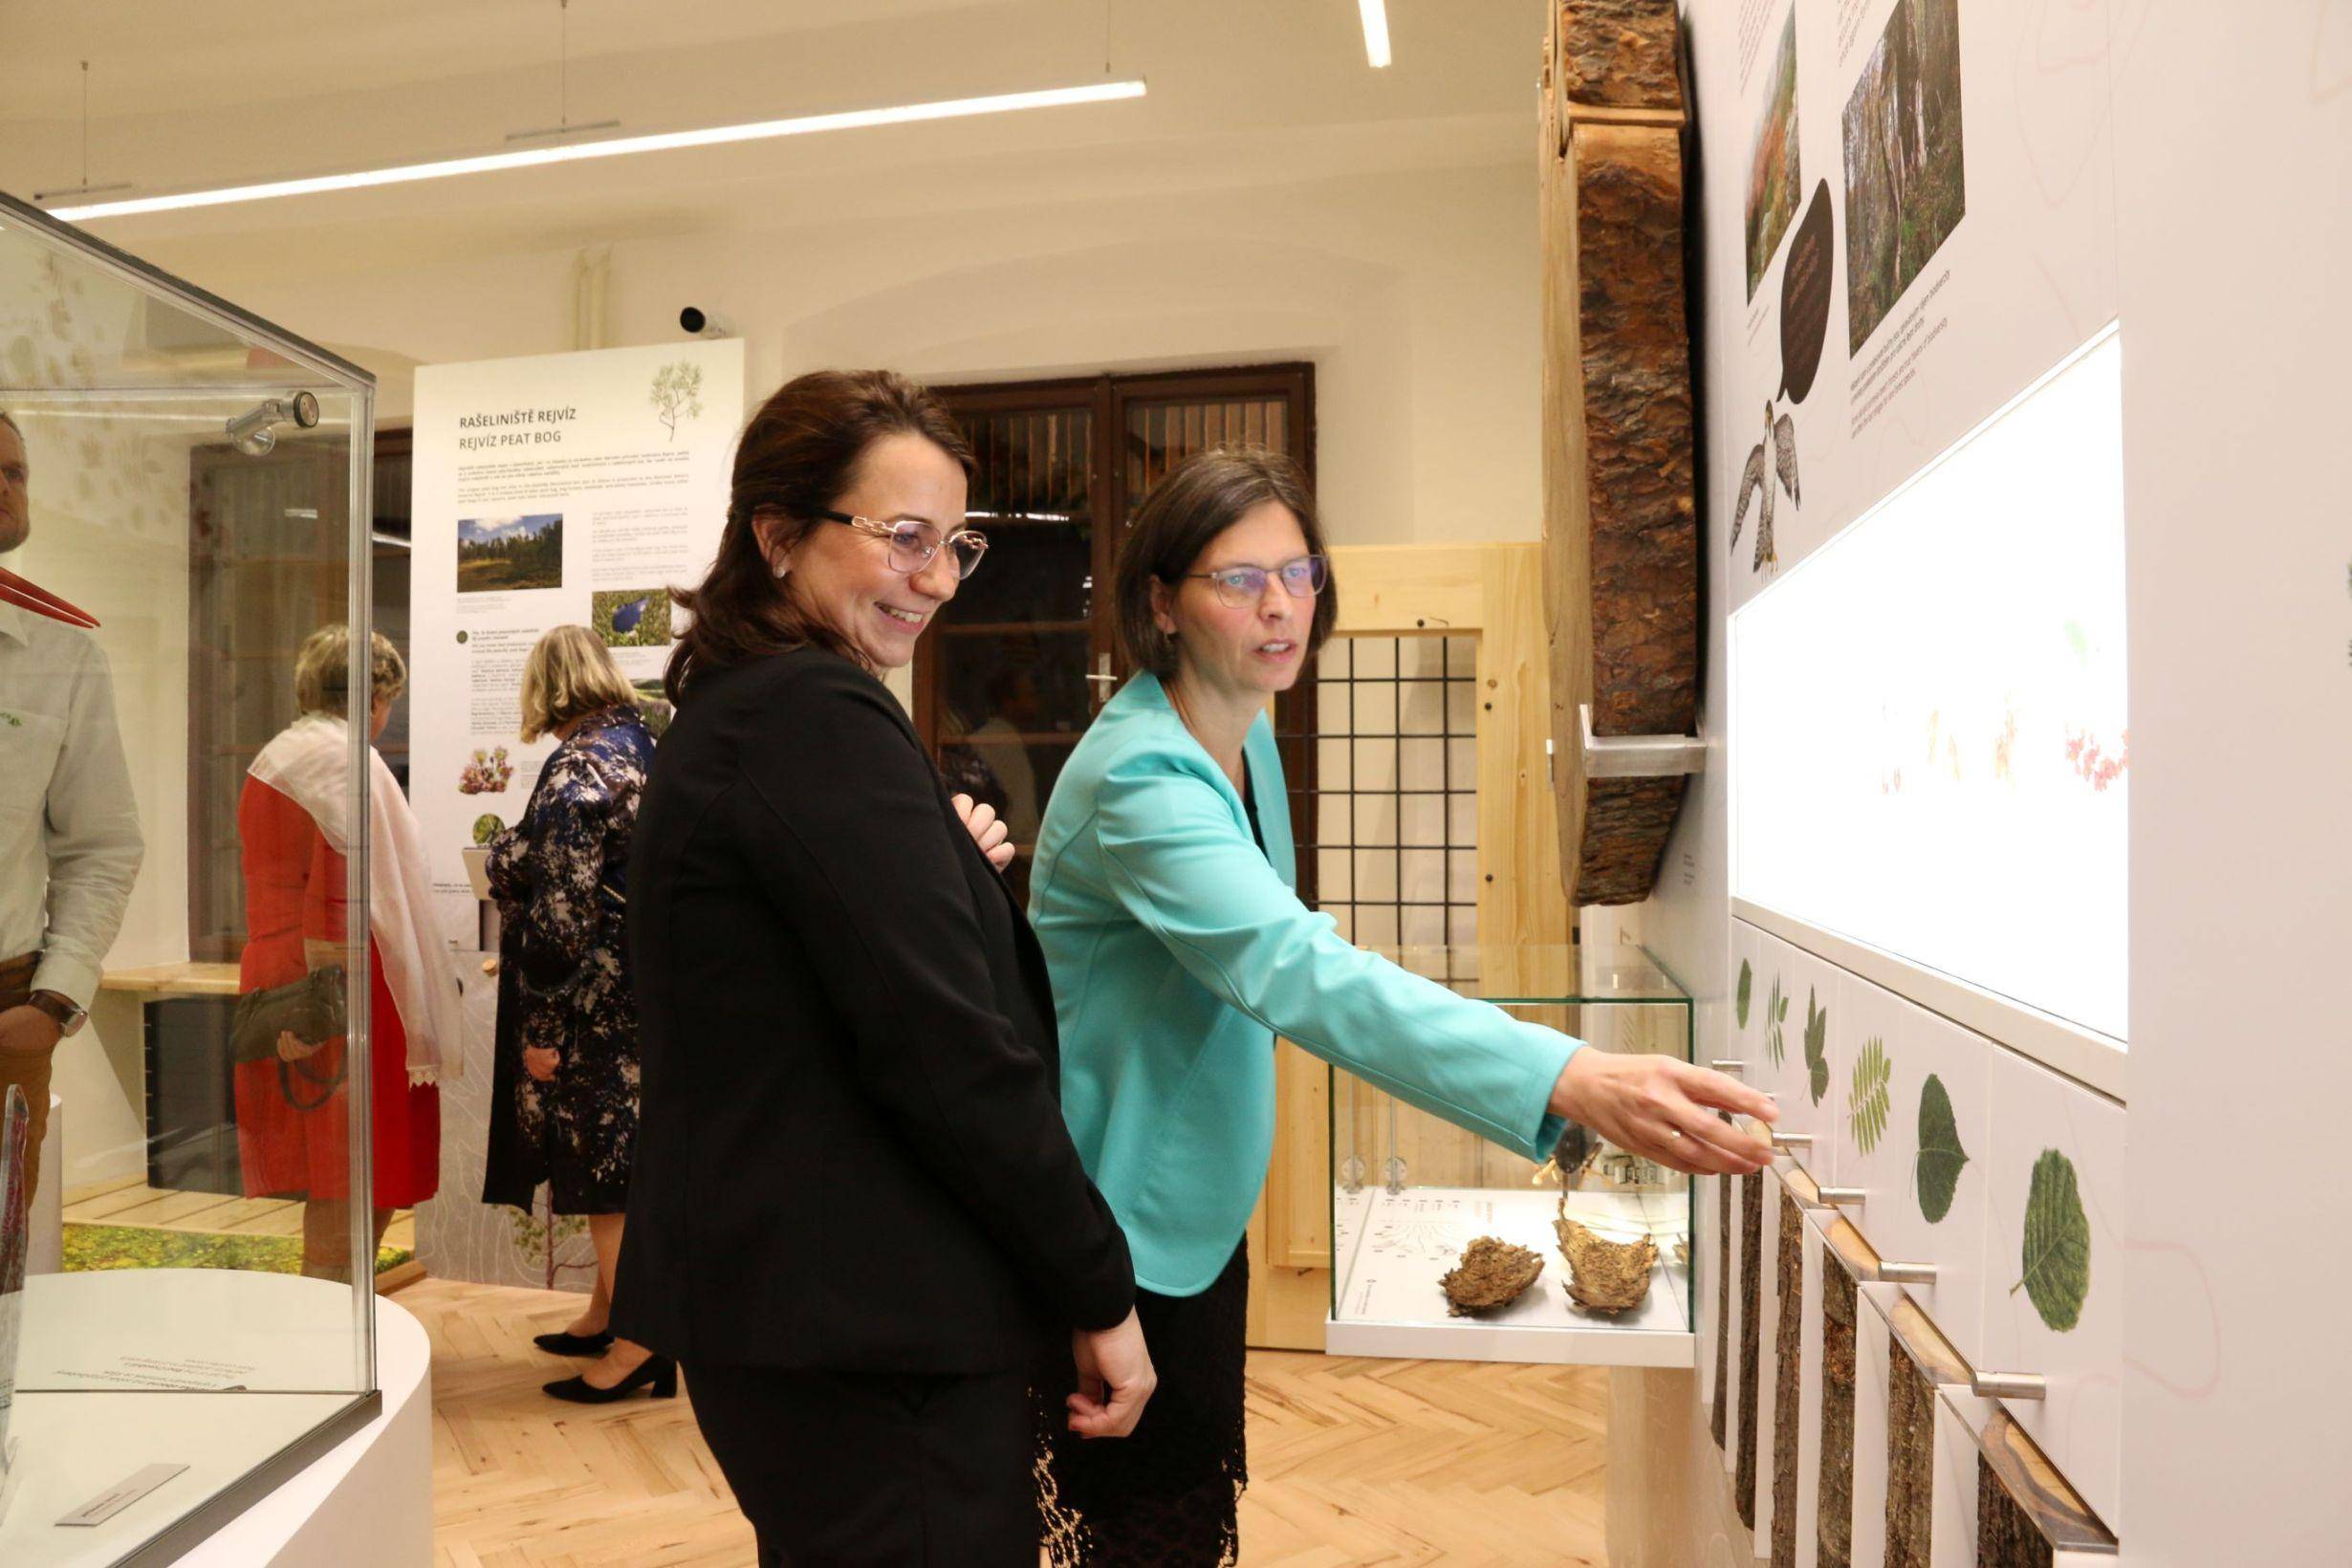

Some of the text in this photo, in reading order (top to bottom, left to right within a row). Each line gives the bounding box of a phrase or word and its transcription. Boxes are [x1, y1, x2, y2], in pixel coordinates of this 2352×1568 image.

[460, 406, 577, 428] RAŠELINIŠTĚ REJVÍZ
[459, 430, 562, 450] REJVÍZ PEAT BOG
